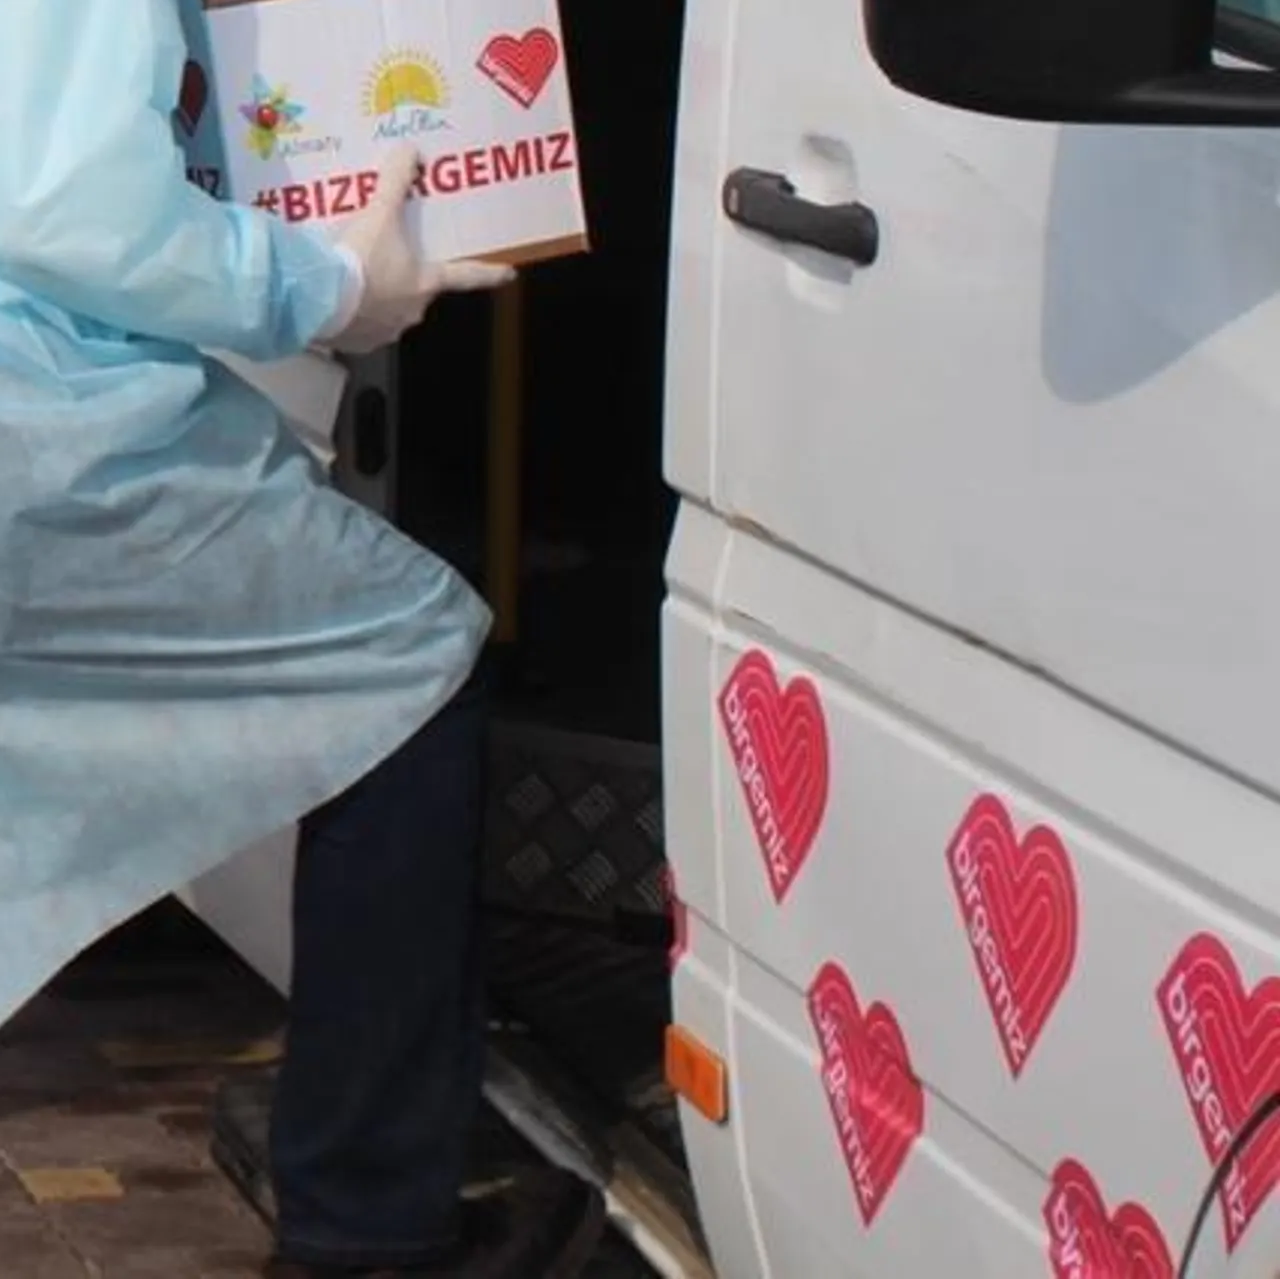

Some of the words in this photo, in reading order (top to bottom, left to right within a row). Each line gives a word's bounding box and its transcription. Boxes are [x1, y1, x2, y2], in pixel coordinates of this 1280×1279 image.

[251, 131, 574, 223] #BIZBRGEMIZ
[724, 681, 790, 886] birgemiz
[953, 830, 1027, 1064] birgemiz
